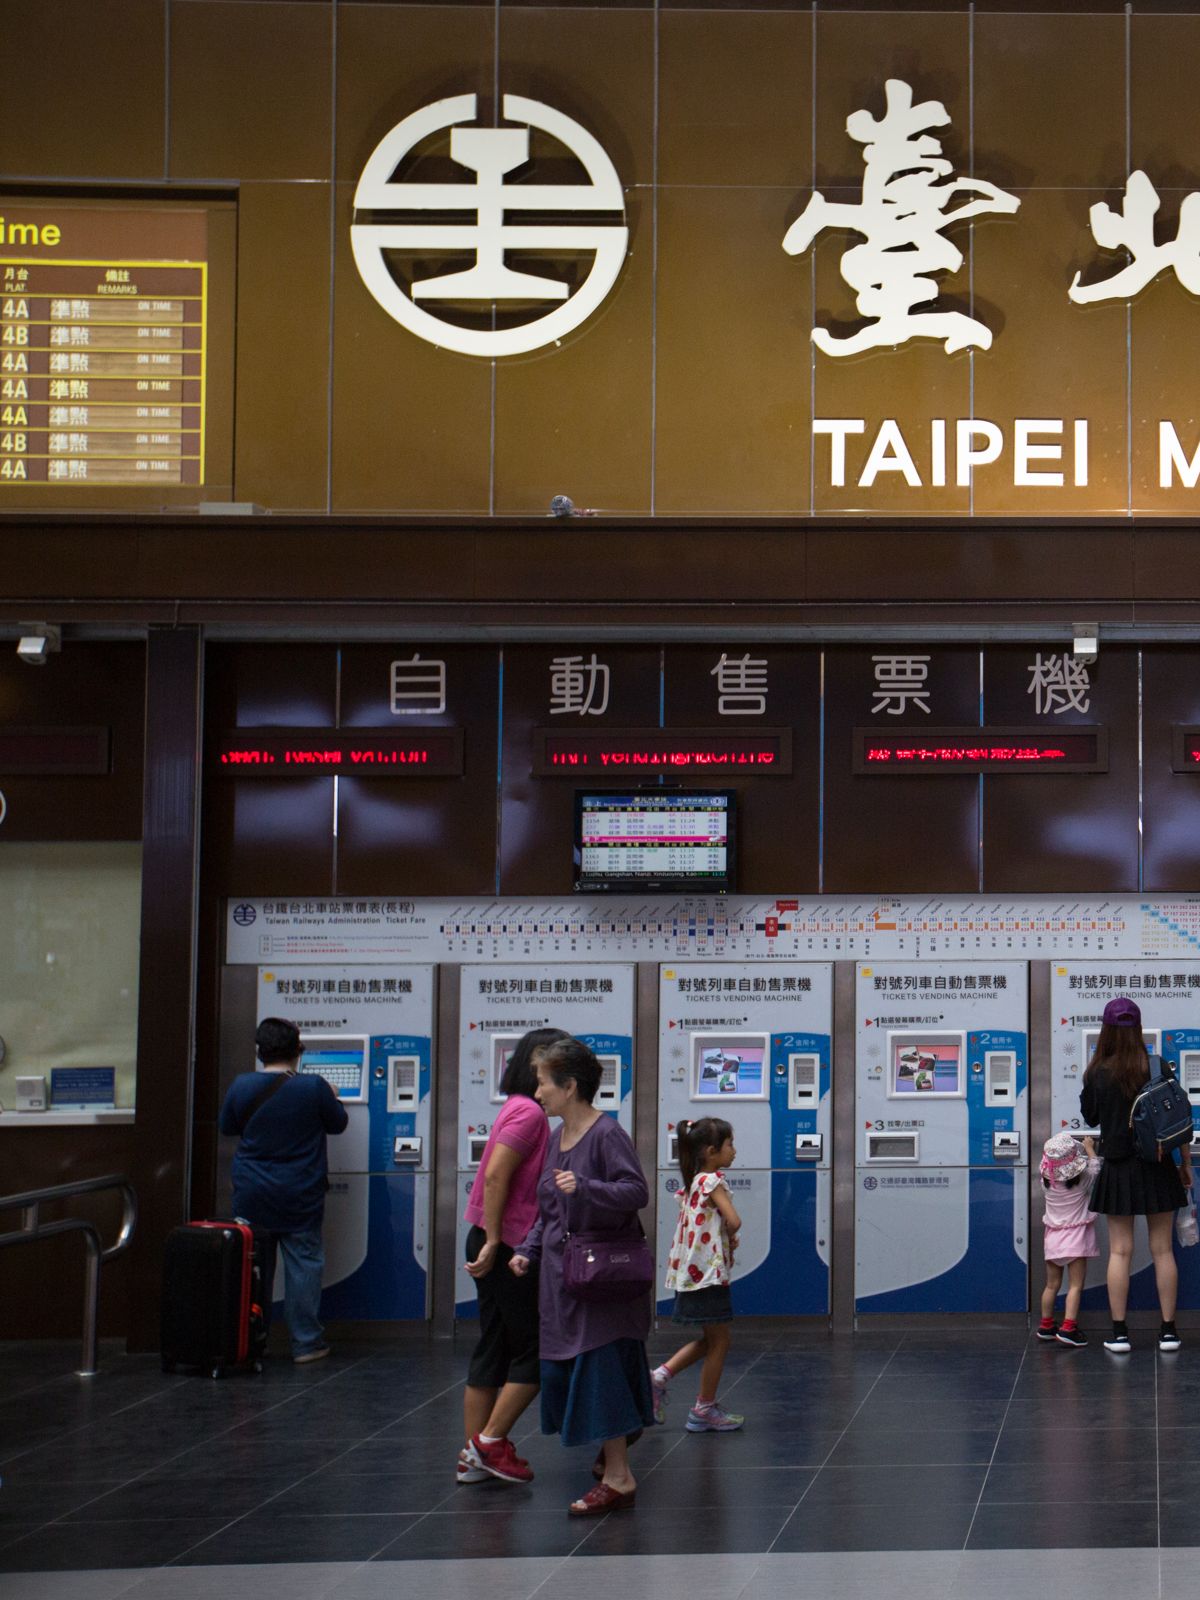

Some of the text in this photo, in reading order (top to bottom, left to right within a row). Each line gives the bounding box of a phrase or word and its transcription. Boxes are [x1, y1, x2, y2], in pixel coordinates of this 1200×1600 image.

[4, 268, 29, 281] 月台
[106, 270, 130, 283] 備註
[98, 285, 138, 295] REMARKS
[2, 299, 29, 318] 4A
[51, 299, 90, 318] 準點
[152, 301, 172, 310] TIME
[2, 327, 29, 345] 4B
[51, 327, 89, 345] 準點
[152, 328, 171, 337] TIME
[2, 353, 28, 372] 4A
[50, 353, 89, 372] 準點
[152, 355, 171, 364] TIME
[2, 380, 28, 398] 4A
[50, 380, 88, 398] 準點
[152, 381, 171, 391] TIME
[1, 407, 27, 425] 4A
[49, 407, 88, 425] 準點
[151, 408, 170, 417] TIME
[1, 433, 27, 452] 4B
[49, 433, 88, 452] 準點
[151, 435, 170, 444] TIME
[812, 418, 1088, 487] TAIPEI
[1, 460, 27, 479] 4A
[49, 460, 87, 479] 準點
[151, 461, 170, 470] TIME
[390, 652, 1091, 716] 自動售票機
[265, 917, 290, 925] Taiwan
[293, 917, 325, 926] Railways
[328, 917, 381, 925] Administration
[386, 917, 408, 925] Ticket
[276, 979, 413, 995] 對號列車自動售票機
[479, 979, 613, 995] 對號列車自動售票機
[678, 977, 812, 993] 對號列車自動售票機
[873, 975, 1008, 990] 對號列車自動售票機
[284, 996, 403, 1004] TICKETS VENDING MACHINE
[487, 996, 604, 1004] TICKETS VENDING MACHINE
[686, 994, 803, 1002] TICKETS VENDING MACHINE
[881, 992, 998, 1000] TICKETS VENDING MACHINE
[384, 1037, 394, 1049] 2
[586, 1037, 596, 1049] 2
[784, 1036, 794, 1047] 2
[980, 1033, 990, 1044] 2
[1175, 1032, 1185, 1043] 2
[477, 1124, 488, 1135] 3
[874, 1120, 885, 1131] 3
[1070, 1118, 1081, 1129] 3
